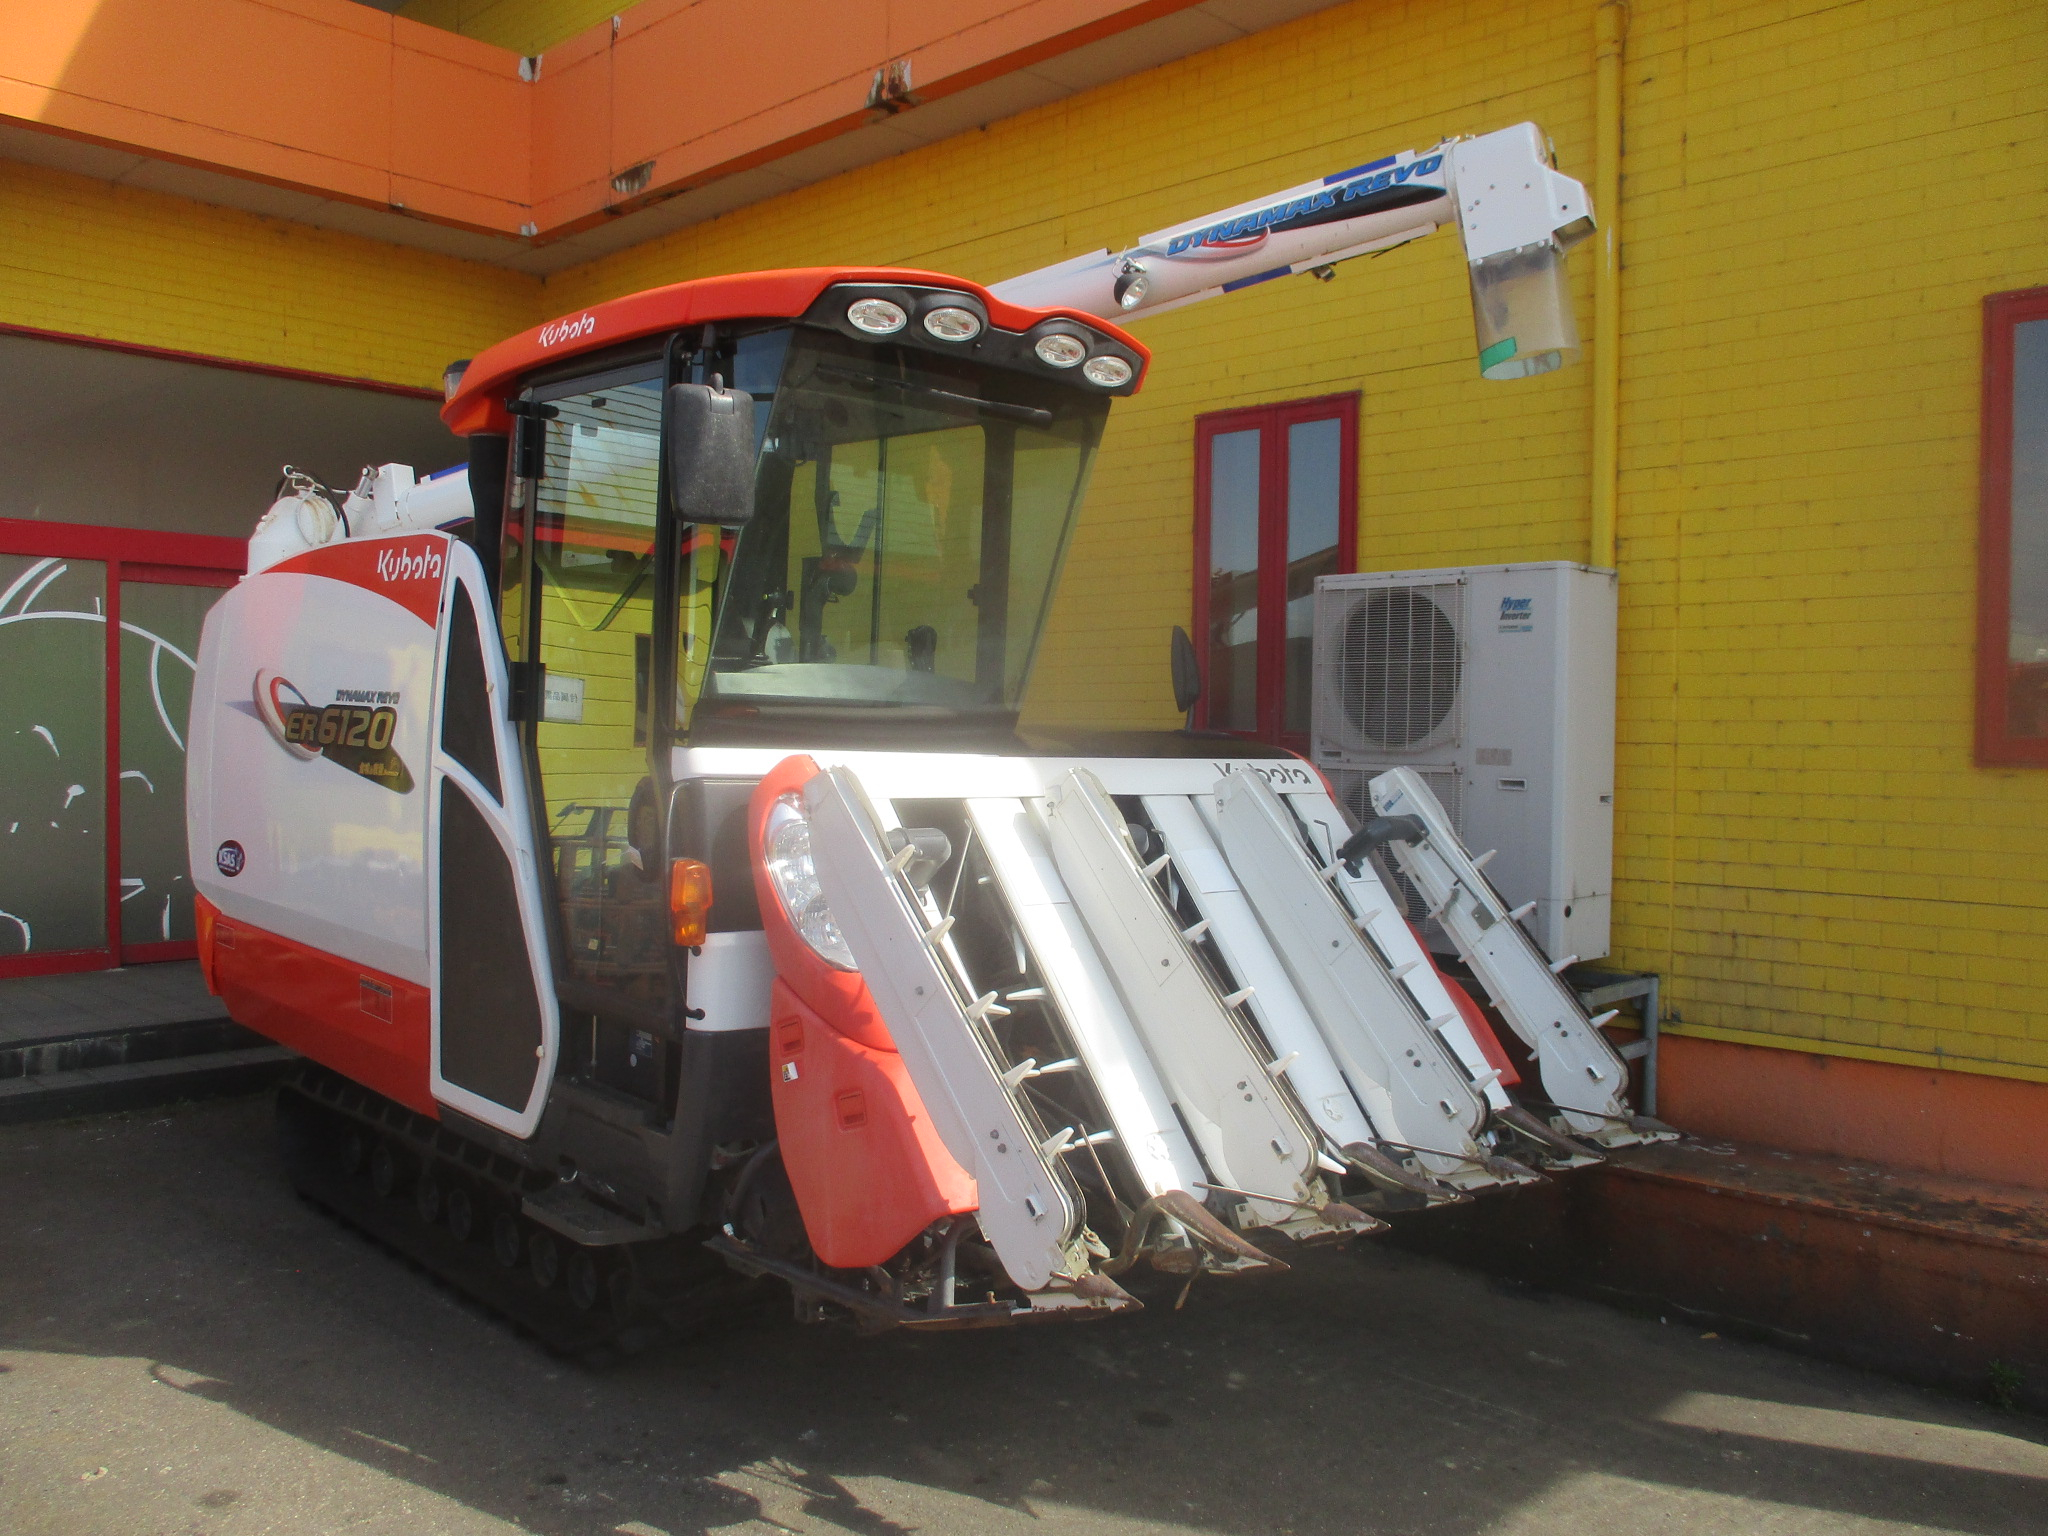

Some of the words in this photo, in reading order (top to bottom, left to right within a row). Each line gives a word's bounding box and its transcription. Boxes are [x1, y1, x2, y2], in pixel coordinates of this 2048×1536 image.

[1166, 185, 1342, 257] DYNAMAX
[1343, 154, 1444, 202] REVO
[538, 313, 595, 347] Kubota
[377, 545, 441, 582] Kubota
[1500, 597, 1532, 611] Hyper
[1500, 611, 1532, 621] Inverter
[286, 709, 394, 750] ER6120
[1213, 762, 1312, 784] Kbota
